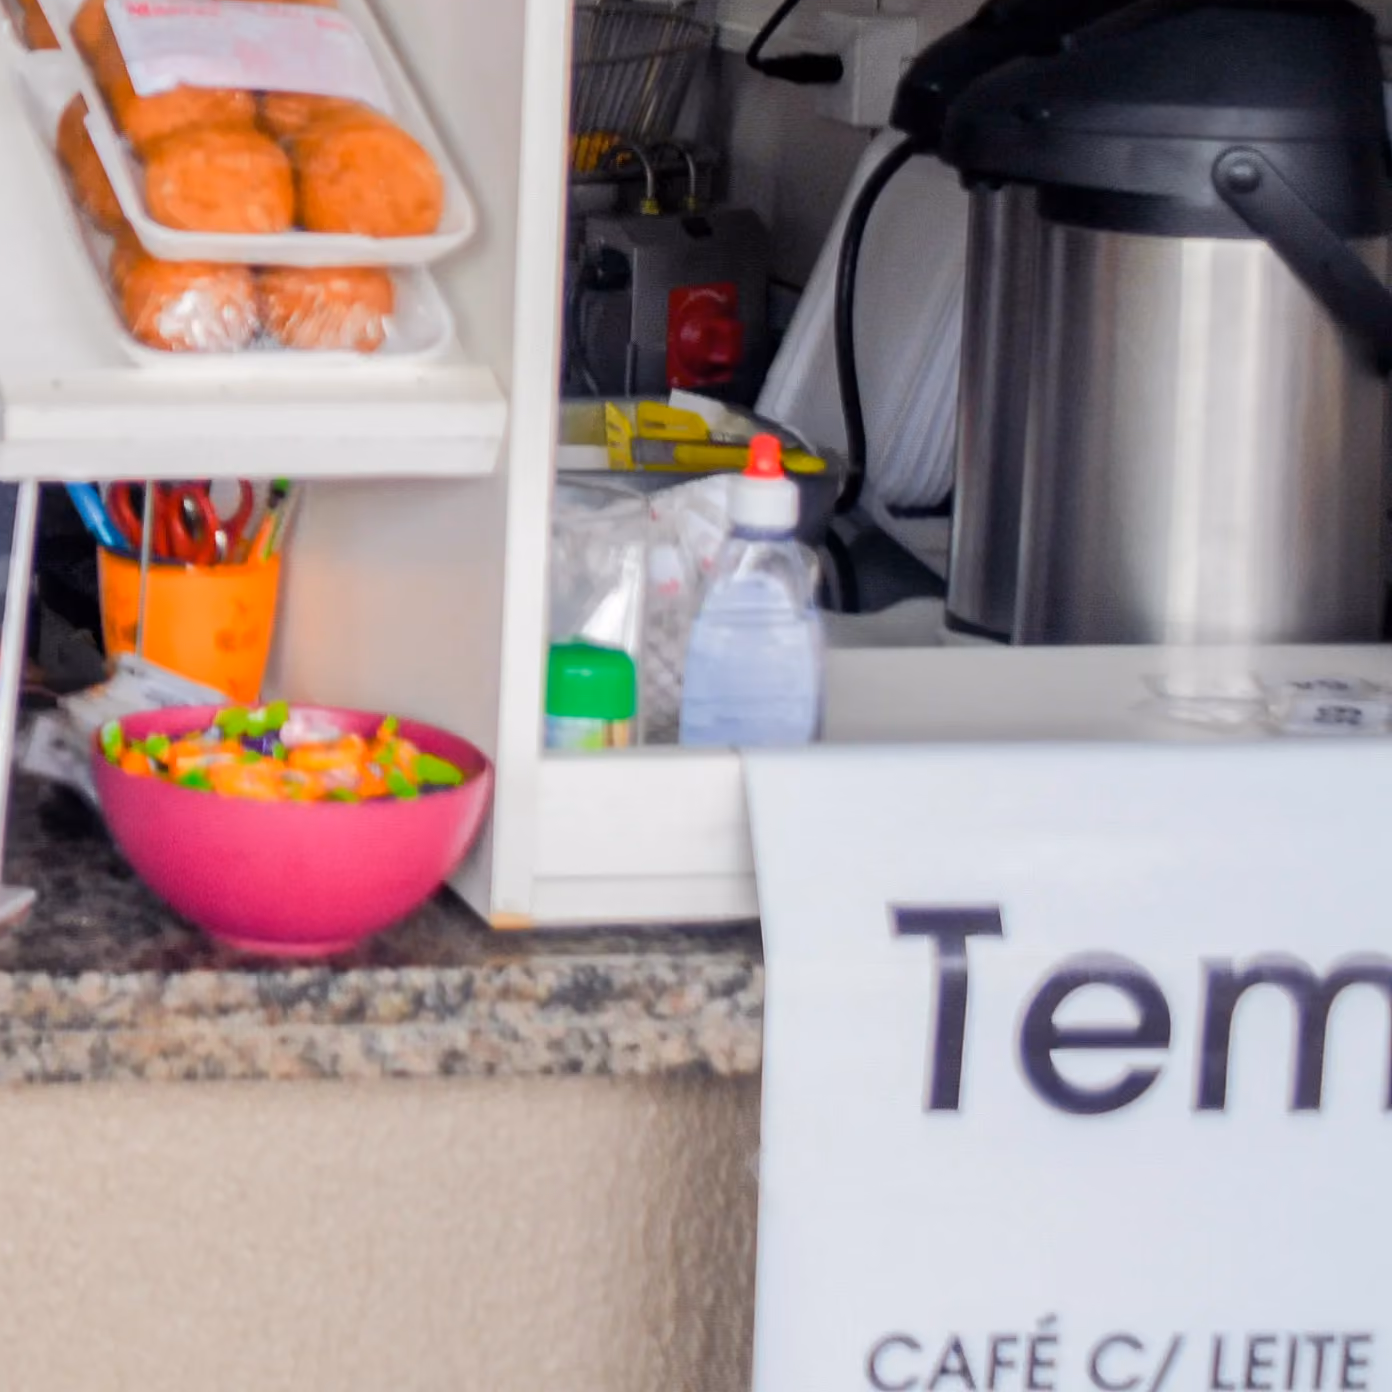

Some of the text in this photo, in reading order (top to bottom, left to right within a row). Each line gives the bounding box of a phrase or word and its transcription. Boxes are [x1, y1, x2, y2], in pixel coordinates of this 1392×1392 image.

[887, 901, 1392, 1114] Tem
[866, 1312, 1374, 1392] CAFÉ C/ LEITE
